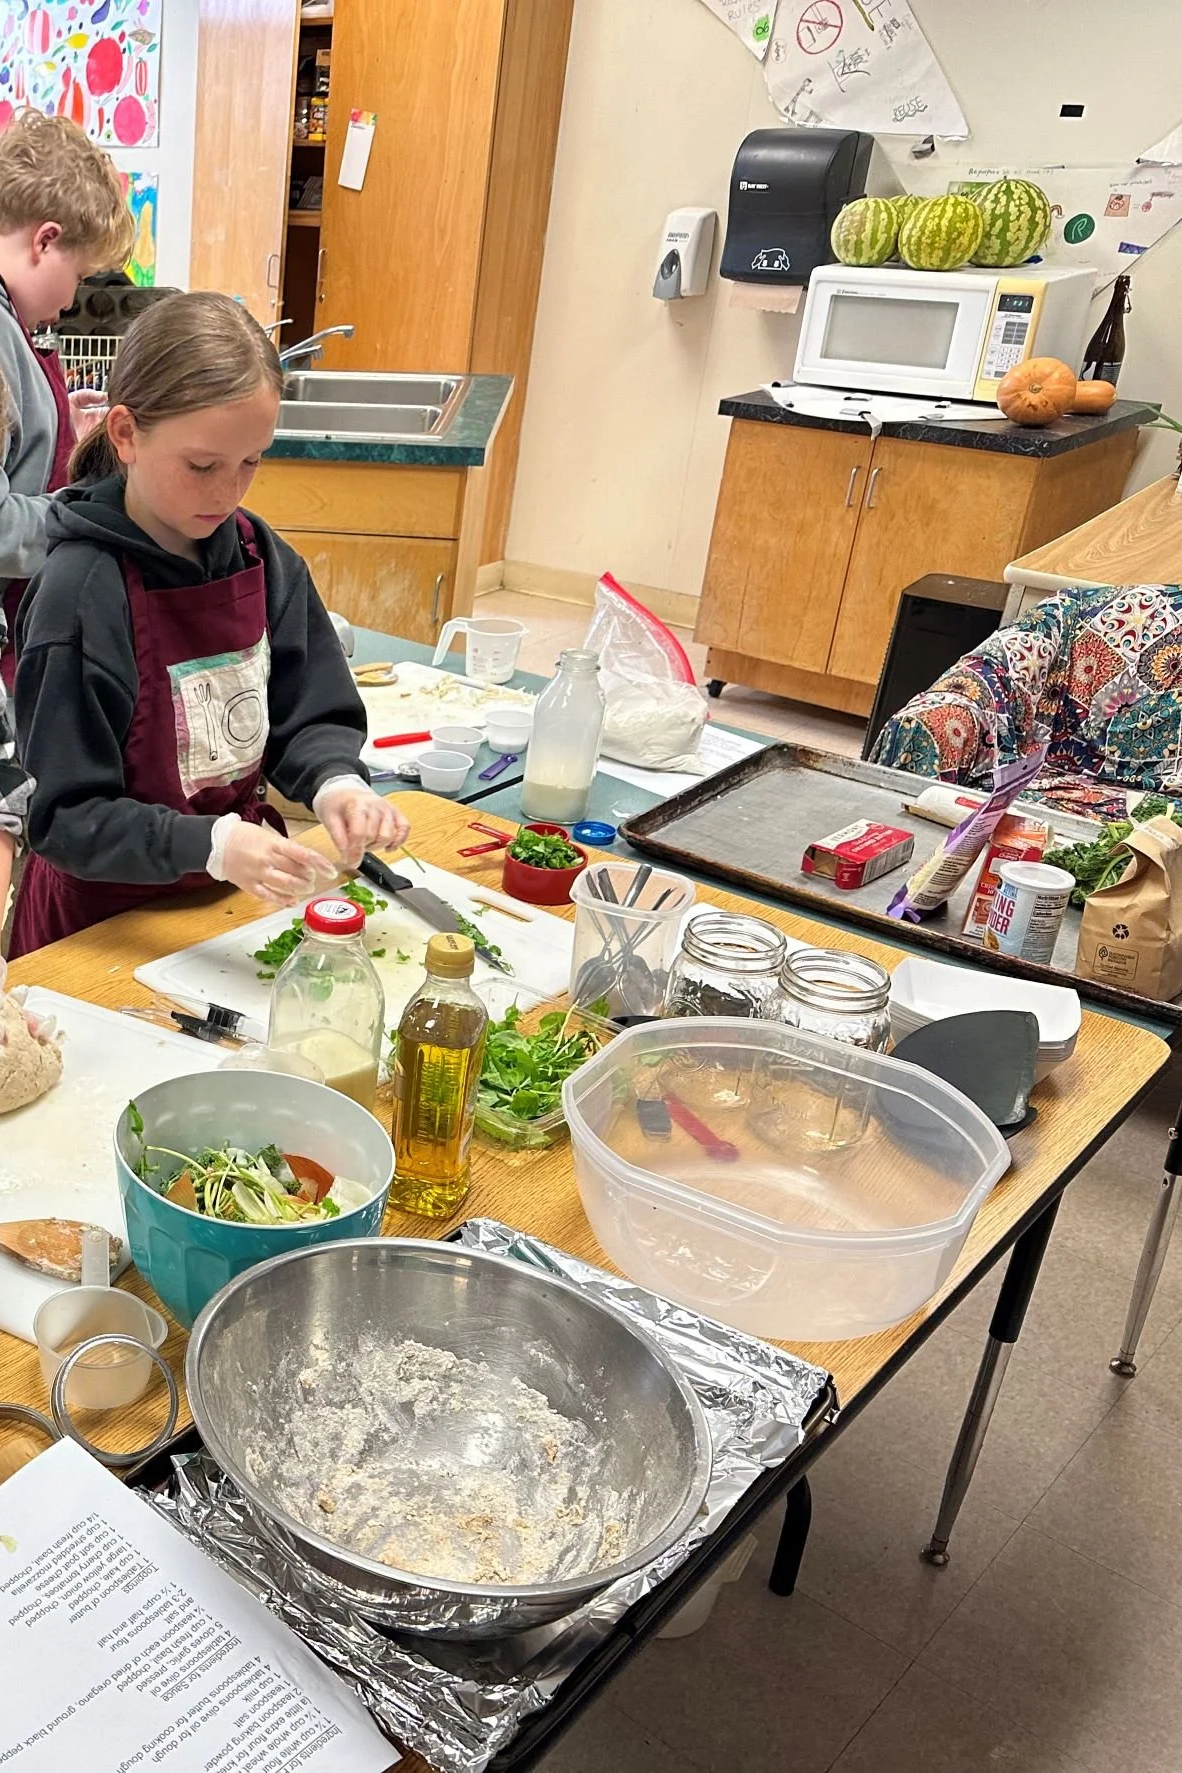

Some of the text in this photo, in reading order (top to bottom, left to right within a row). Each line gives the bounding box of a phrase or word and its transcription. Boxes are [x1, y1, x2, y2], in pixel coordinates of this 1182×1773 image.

[86, 1511, 99, 1523] 1/4
[71, 1520, 87, 1534] cup
[86, 1523, 101, 1536] cup
[51, 1531, 73, 1549] fresh
[94, 1530, 109, 1544] cup
[102, 1538, 117, 1551] cup
[31, 1547, 55, 1566] basil,
[51, 1534, 87, 1566] shredded
[78, 1542, 95, 1557] soft
[105, 1545, 127, 1563] large
[61, 1552, 80, 1571] goat
[78, 1550, 103, 1571] cherry
[119, 1553, 134, 1567] cup
[10, 1562, 52, 1596] mozzarella
[34, 1568, 63, 1591] cheese
[82, 1560, 107, 1583] yellow
[99, 1565, 121, 1581] kale,
[99, 1562, 145, 1599] Tablespoon
[120, 1561, 159, 1594] Toppings
[41, 1569, 81, 1599] tomatoes,
[57, 1581, 83, 1600] onion,
[67, 1581, 101, 1611] chopped
[90, 1597, 100, 1608] of
[142, 1593, 162, 1611] cups
[7, 1598, 42, 1626] chopped
[24, 1600, 59, 1628] chopped
[68, 1604, 93, 1624] butter
[127, 1609, 145, 1625] half
[163, 1596, 194, 1624] and salt
[109, 1588, 187, 1652] 2-3 tablespoons flour
[111, 1621, 128, 1636] and
[158, 1612, 196, 1643] teaspoon
[190, 1618, 206, 1633] cup
[96, 1633, 115, 1648] half
[139, 1640, 161, 1657] each
[170, 1631, 193, 1649] fresh
[131, 1655, 142, 1666] of
[135, 1621, 223, 1693] 5 cloves garlic, pressed
[149, 1646, 174, 1665] basil,
[149, 1629, 231, 1697] 4 tablespoons olive oil
[110, 1662, 132, 1681] dried
[116, 1663, 151, 1693] chopped
[162, 1637, 242, 1702] Ingredients for Sauce
[74, 1678, 112, 1706] oregano,
[218, 1668, 266, 1706] tablespoons
[258, 1676, 274, 1690] cup
[241, 1687, 260, 1703] milk
[248, 1684, 286, 1714] teaspoon
[299, 1695, 312, 1705] (a
[45, 1705, 76, 1732] ground
[116, 1655, 261, 1772] 4 tablespoons butter for cooking dough
[199, 1705, 220, 1722] olive
[284, 1702, 304, 1718] little
[313, 1706, 321, 1714] 1
[189, 1721, 201, 1733] oil
[203, 1687, 302, 1772] 2 teaspoon baking powder
[233, 1712, 250, 1728] salt
[264, 1716, 286, 1735] extra
[289, 1717, 306, 1732] cup
[323, 1716, 331, 1724] 1
[22, 1728, 49, 1746] black
[177, 1729, 192, 1742] for
[247, 1733, 268, 1751] flour
[266, 1730, 291, 1751] whole
[300, 1727, 316, 1741] cup
[151, 1739, 179, 1763] dough
[234, 1749, 250, 1762] for
[279, 1739, 302, 1758] white
[288, 1724, 343, 1770] Ingredients for
[242, 1749, 269, 1772] wheat
